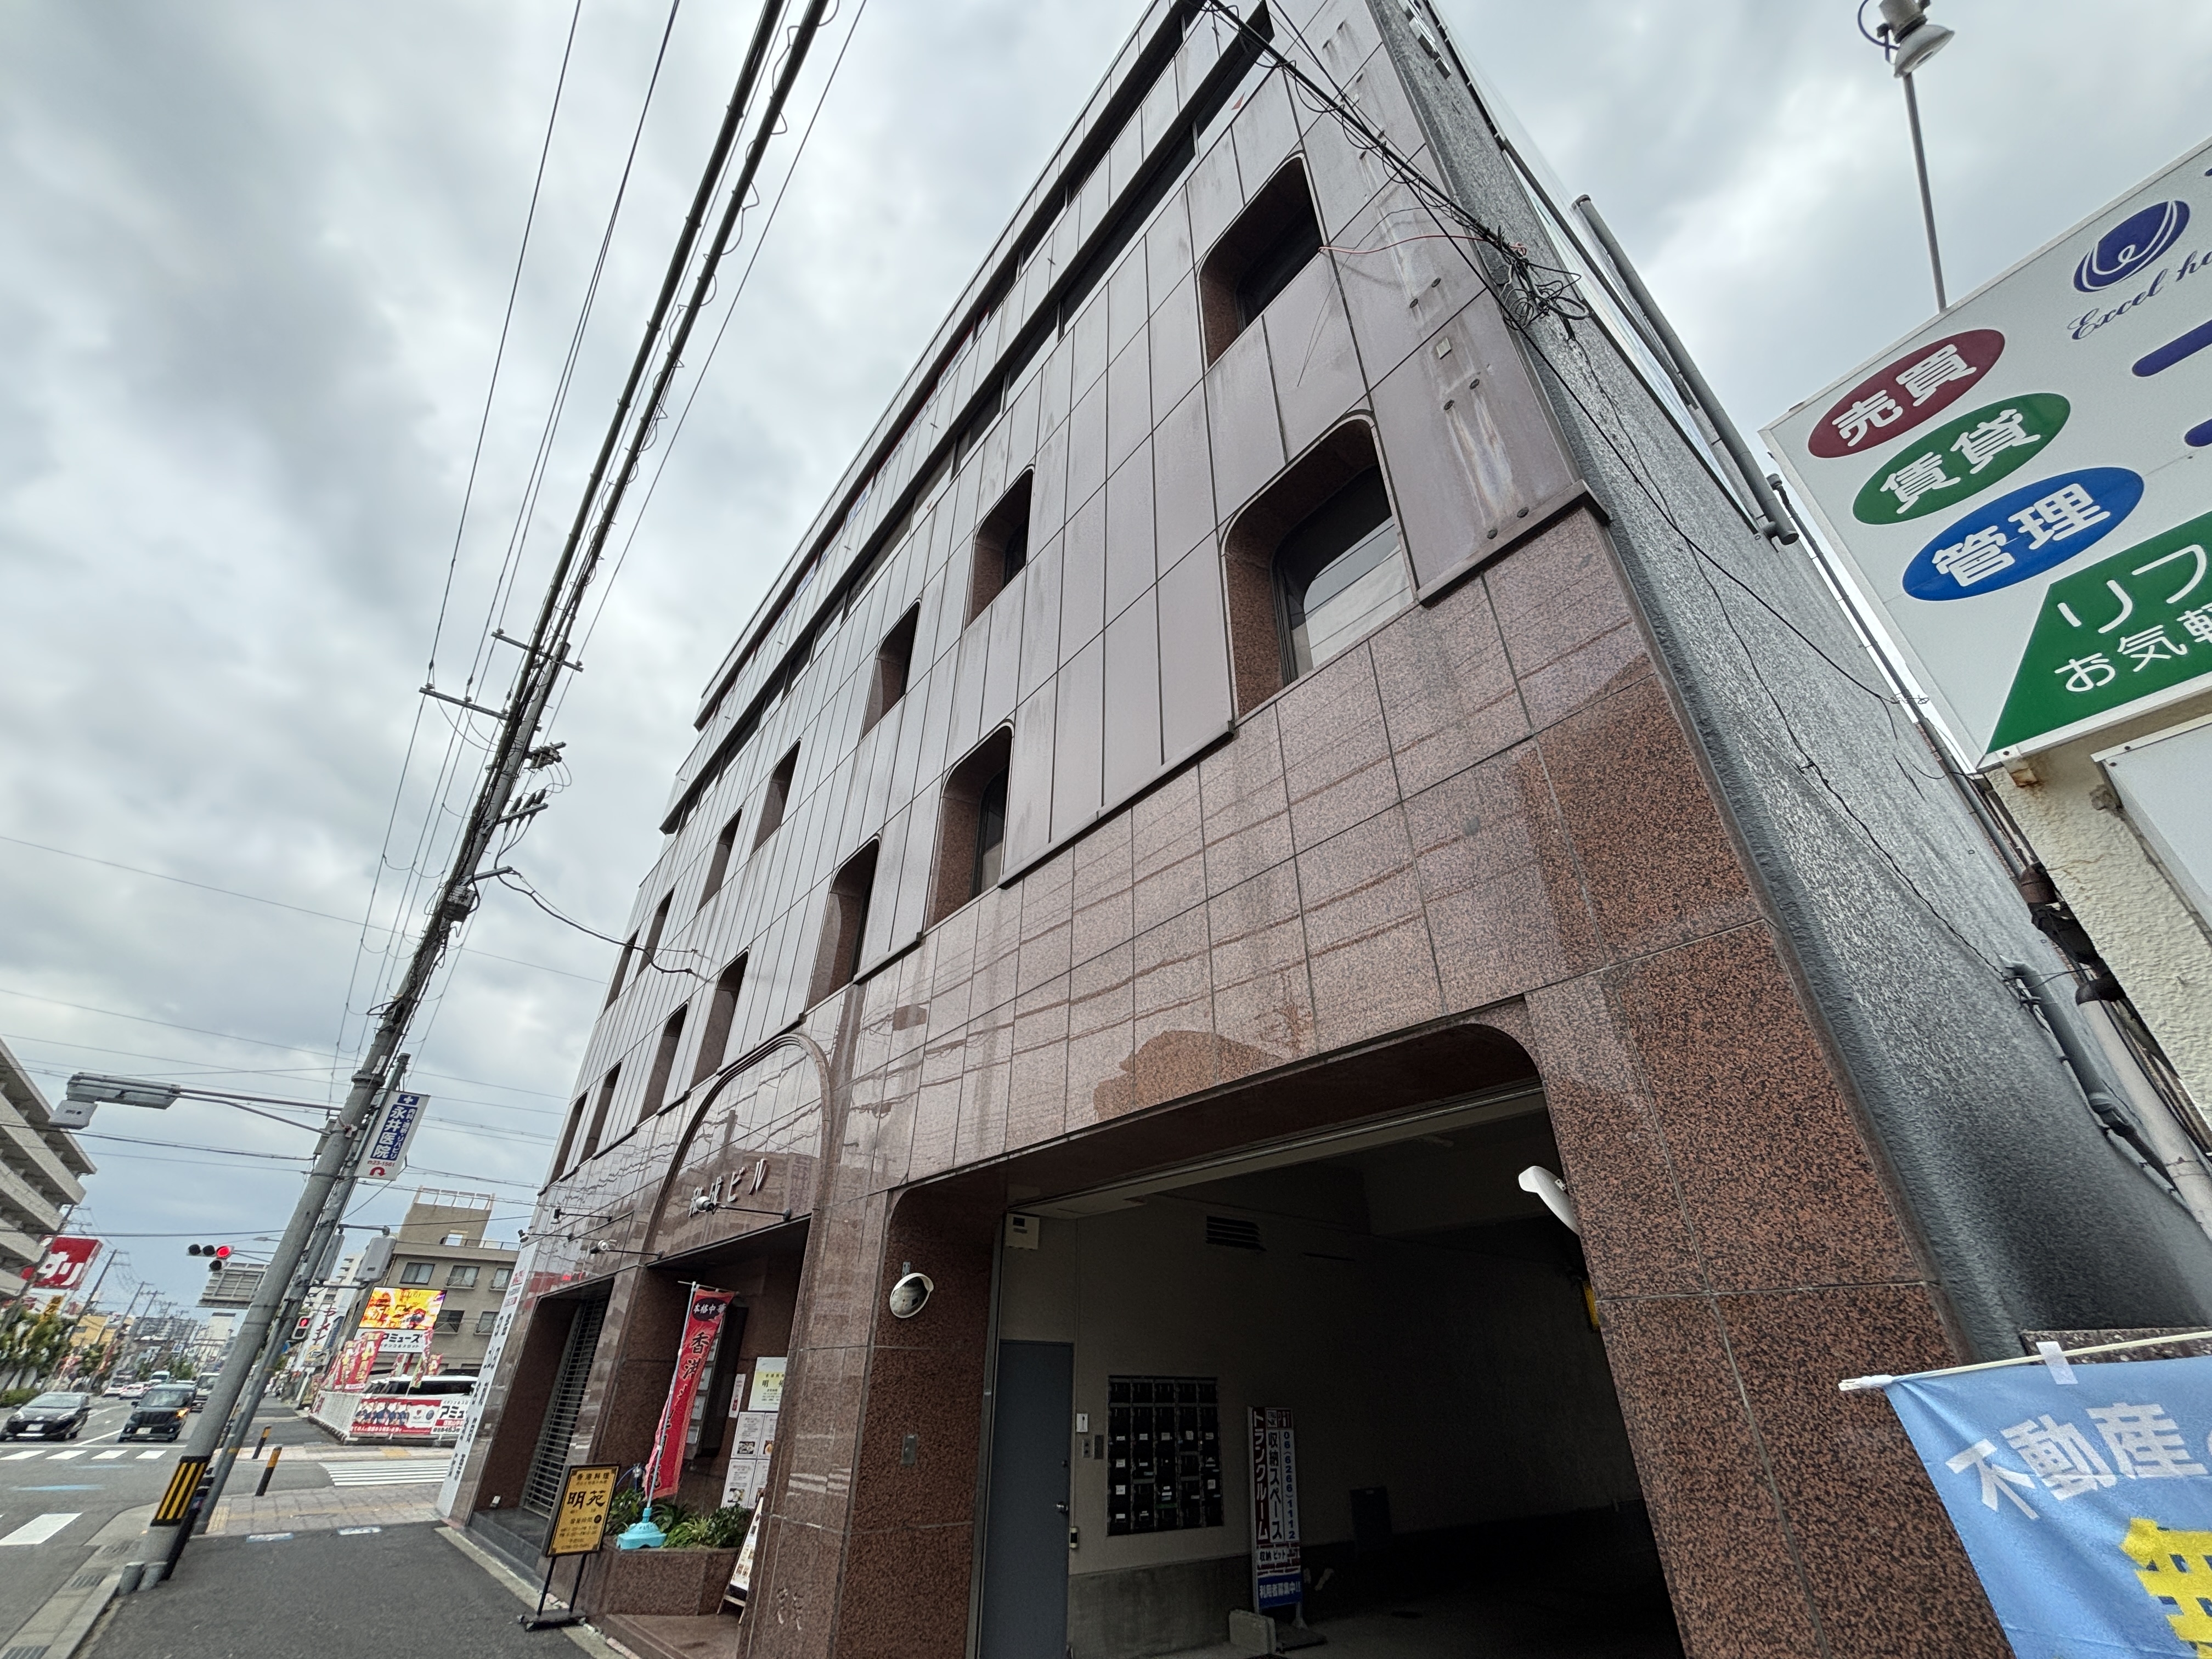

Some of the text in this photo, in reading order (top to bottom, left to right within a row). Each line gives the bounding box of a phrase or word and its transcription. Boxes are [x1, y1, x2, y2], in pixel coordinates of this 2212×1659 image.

[2067, 268, 2168, 340] Excel
[1832, 343, 1977, 447] 売買
[1880, 408, 2041, 514] 賃貸
[1932, 483, 2111, 587] 管理
[2057, 544, 2207, 633] リフ
[373, 1106, 407, 1158] 永井医院
[693, 1304, 726, 1316] 本格中華
[567, 1491, 606, 1509] 明苑
[1254, 1410, 1269, 1540] トランクルーム
[1268, 1432, 1282, 1539] 収納スペース
[1945, 1403, 2212, 1519] 不動産
